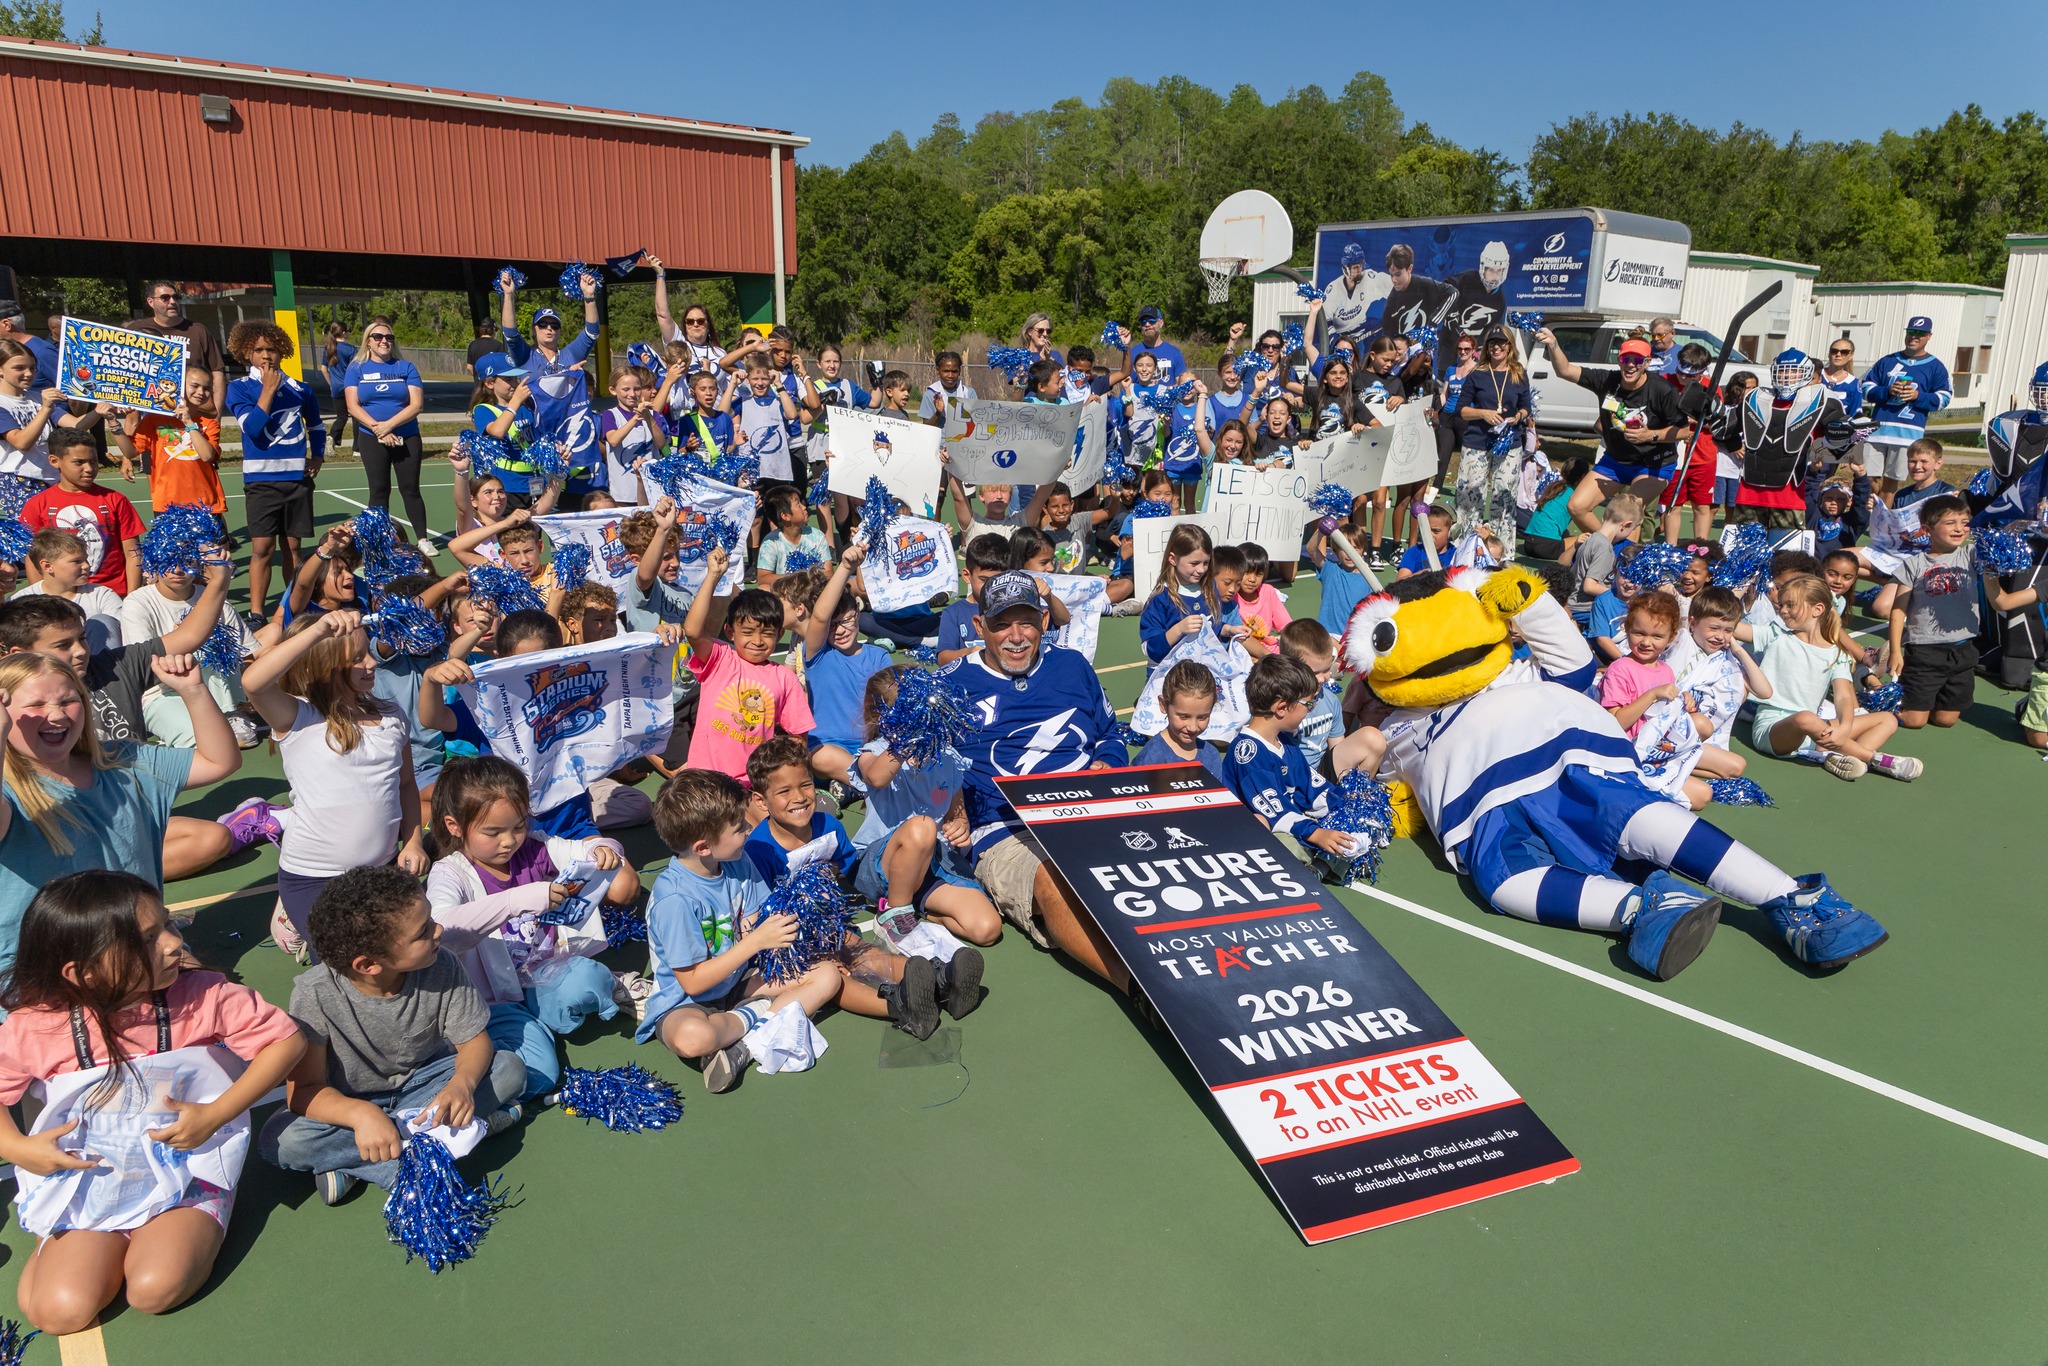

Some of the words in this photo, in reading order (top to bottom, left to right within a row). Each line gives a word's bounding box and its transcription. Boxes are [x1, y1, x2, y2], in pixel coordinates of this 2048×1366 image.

[1532, 256, 1567, 264] COMMUNITY
[1543, 262, 1582, 270] DEVELOPMENT
[1621, 262, 1658, 276] COMMUNITY
[1658, 266, 1664, 276] &
[1619, 273, 1642, 286] HOCKEY
[1642, 276, 1683, 290] DEVELOPMENT
[79, 325, 170, 358] CONGRATS!
[100, 343, 150, 362] COACH
[88, 352, 160, 377] TASSONE
[102, 368, 138, 379] OAKSTEAD'S
[95, 374, 106, 382] #1
[106, 374, 129, 384] DRAFT
[130, 378, 146, 388] PICK
[102, 386, 120, 394] NHL'S
[121, 388, 142, 398] MOST
[94, 391, 124, 402] VALUABLE
[126, 395, 152, 408] TEACHER
[834, 408, 854, 418] LETS
[858, 412, 872, 423] GO
[1016, 406, 1060, 424] GO
[1790, 416, 1812, 432] BAUER
[1822, 523, 1842, 534] NASA
[894, 539, 935, 563] STADIUM
[992, 575, 1032, 587] LIGHTNING
[622, 660, 630, 694] LIGHTNING
[498, 683, 508, 706] TAMPA
[524, 672, 604, 723] STADIUM
[540, 686, 590, 718] SERIES
[623, 695, 631, 708] BAY
[624, 708, 632, 728] TAMPA
[712, 719, 730, 734] OES
[1026, 789, 1093, 802] SECTION
[1111, 784, 1150, 795] ROW
[1170, 780, 1204, 790] SEAT
[1052, 806, 1090, 817] 0001
[1136, 800, 1154, 810] 01
[1194, 795, 1212, 804] 01
[1252, 788, 1284, 818] 86
[1133, 834, 1148, 848] NHL
[1168, 840, 1204, 850] NHLPA
[1088, 848, 1284, 892] FUTURE
[1113, 872, 1306, 918] GOALS
[1148, 934, 1216, 954] MOST
[1223, 917, 1338, 943] VALUABLE
[1238, 980, 1353, 1023] 2026
[1218, 1008, 1422, 1066] WINNER
[1260, 1088, 1297, 1120] 2
[1295, 1054, 1459, 1110] TICKETS
[1280, 1124, 1309, 1142] to
[1318, 1115, 1350, 1134] an
[1349, 1096, 1412, 1126] NHL
[1415, 1084, 1478, 1112] event
[1312, 1173, 1335, 1186] This
[1336, 1172, 1346, 1180] is
[1346, 1167, 1362, 1180] not
[1364, 1166, 1372, 1174] a
[1374, 1159, 1394, 1172] real
[1394, 1152, 1424, 1168] ticket.
[1424, 1144, 1458, 1159] Official
[1458, 1136, 1488, 1151] tickets
[1488, 1130, 1505, 1142] will
[1506, 1128, 1520, 1138] be
[1354, 1173, 1406, 1194] distributed
[1406, 1166, 1438, 1180] before
[1439, 1160, 1456, 1172] the
[1456, 1154, 1482, 1168] event
[1482, 1148, 1504, 1161] date
